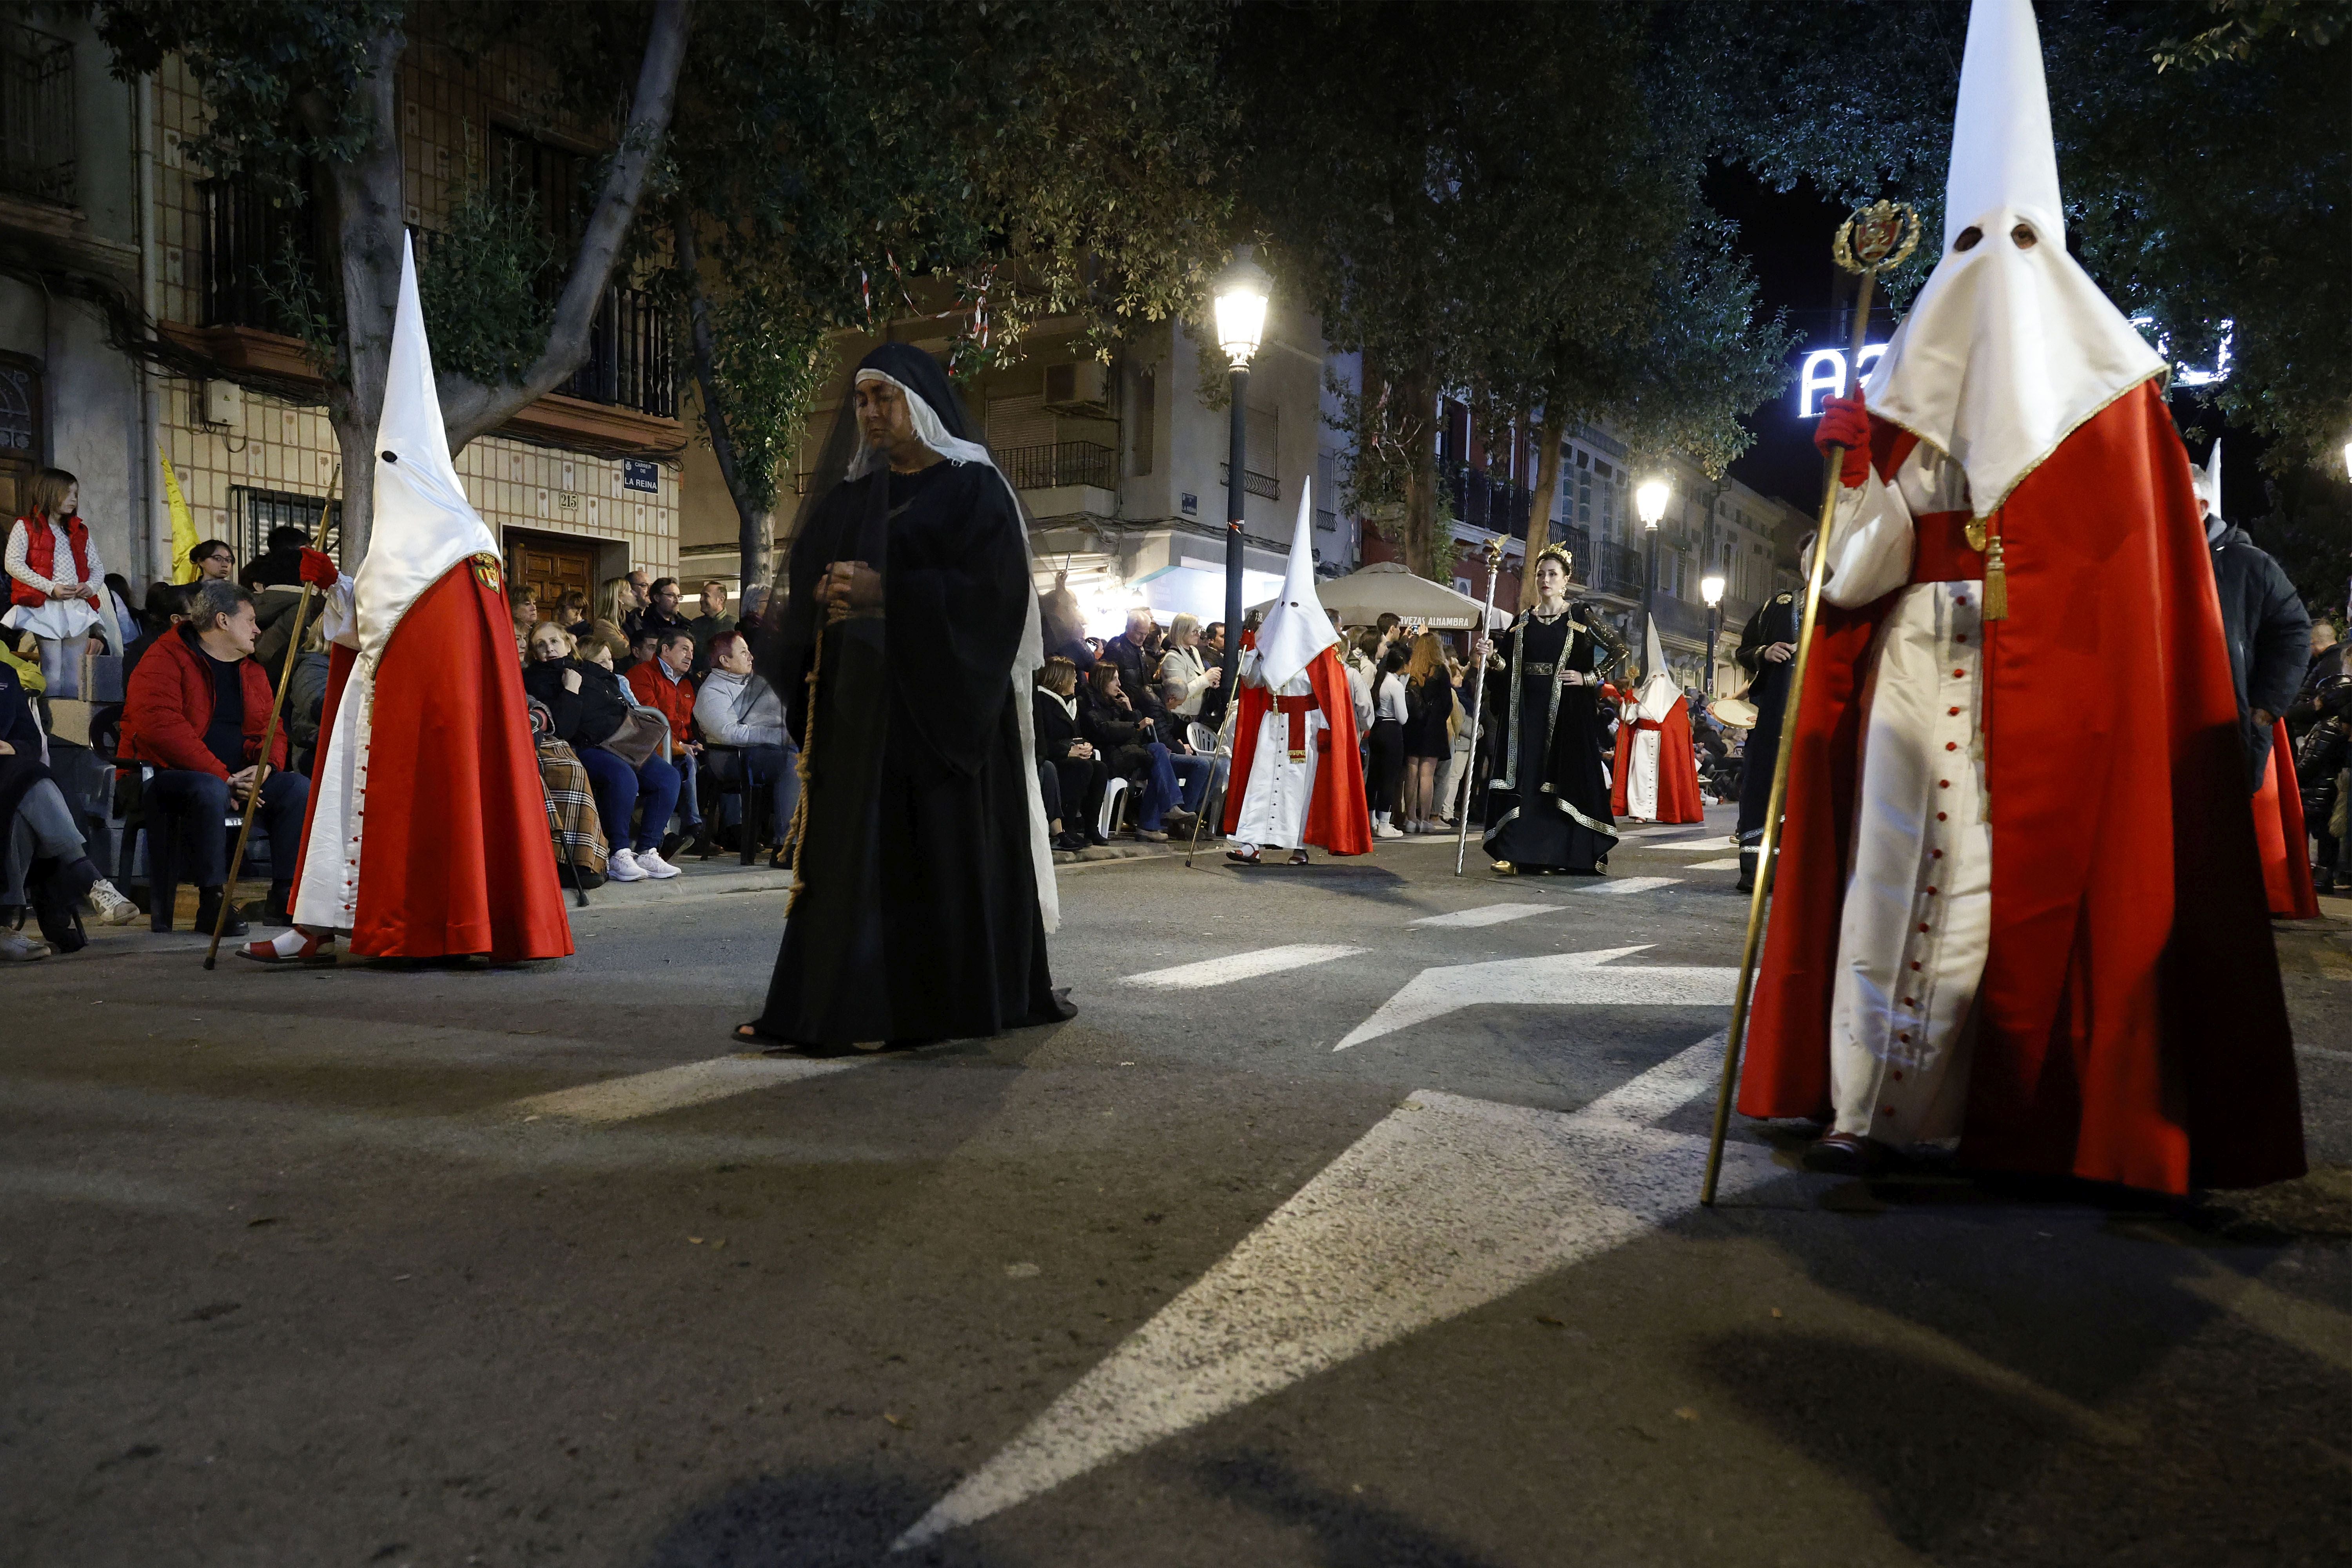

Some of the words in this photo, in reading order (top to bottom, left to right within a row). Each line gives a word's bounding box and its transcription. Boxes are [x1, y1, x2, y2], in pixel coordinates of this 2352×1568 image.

[624, 477, 634, 486] LA
[635, 479, 657, 490] REINA
[561, 494, 577, 508] 215
[1399, 616, 1426, 626] RVEZAS
[1428, 617, 1469, 626] ALHAMBRA
